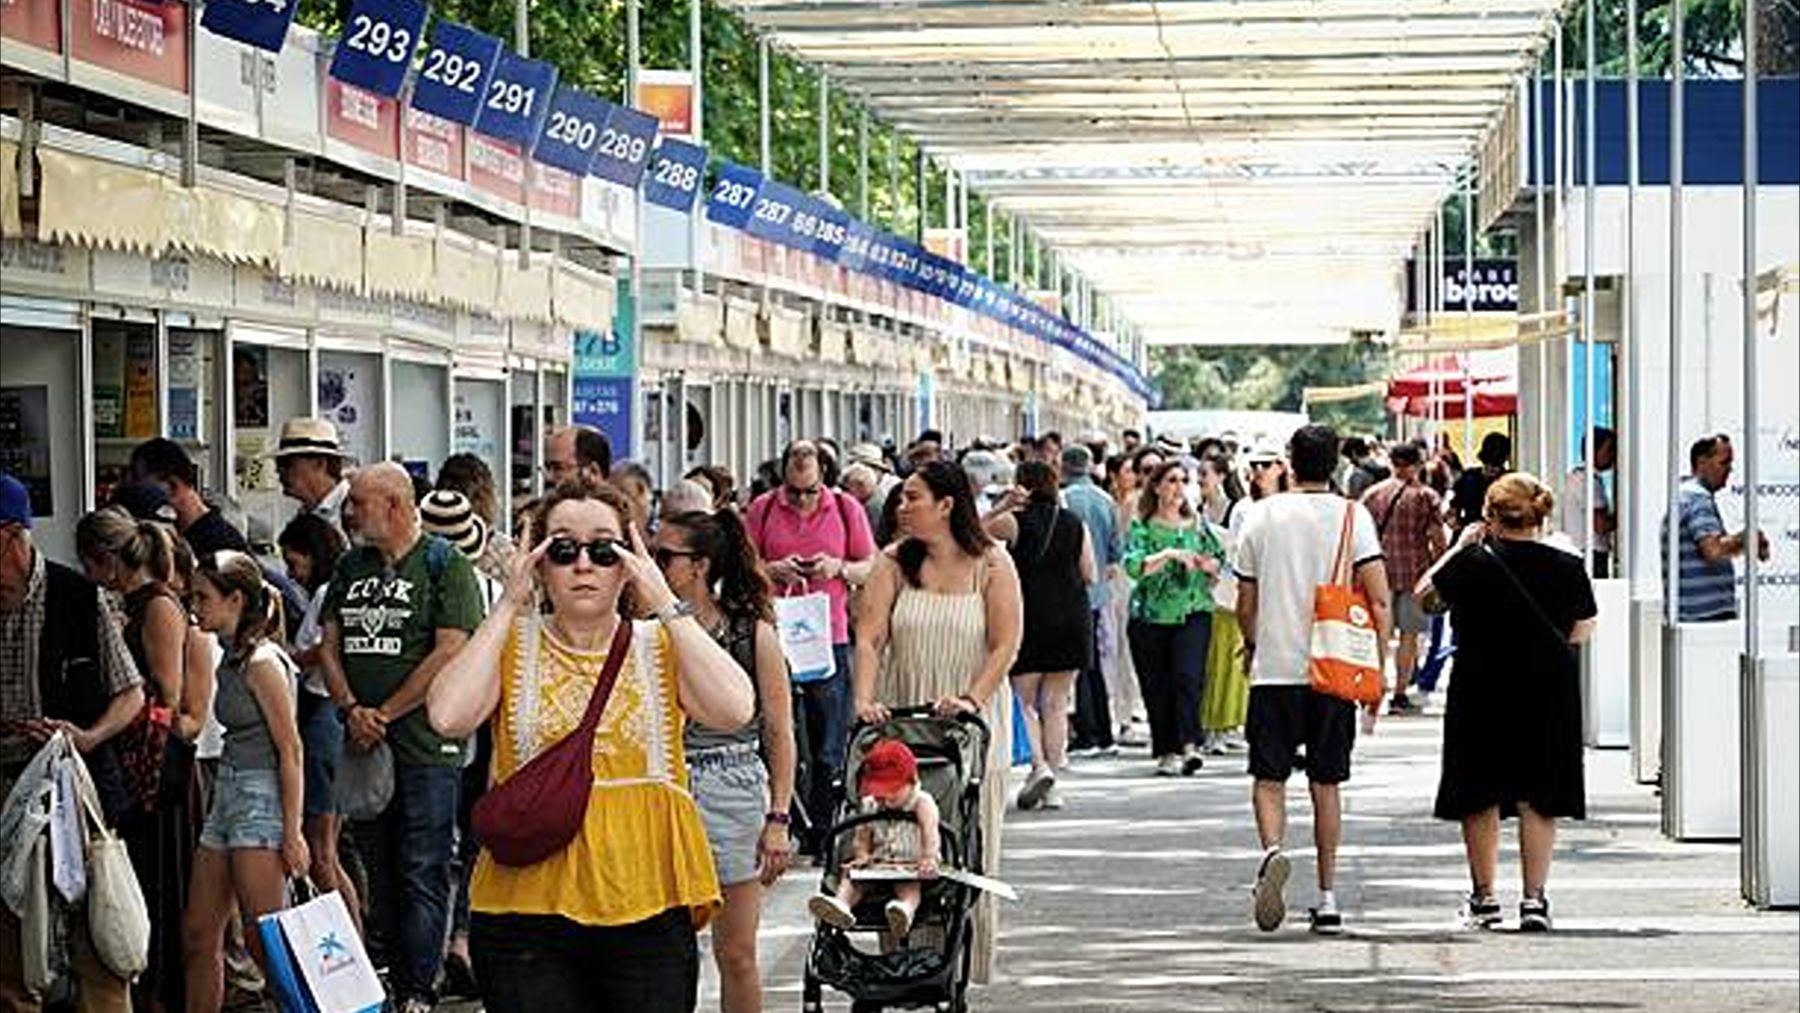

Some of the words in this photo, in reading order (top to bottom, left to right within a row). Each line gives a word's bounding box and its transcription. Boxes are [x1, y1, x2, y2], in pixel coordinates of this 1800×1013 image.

[347, 15, 411, 62] 293
[424, 49, 481, 93] 292
[487, 80, 535, 117] 291
[546, 112, 597, 150] 290
[599, 129, 646, 163] 289
[655, 158, 699, 191] 288
[714, 179, 755, 209] 287
[754, 198, 792, 224] 287
